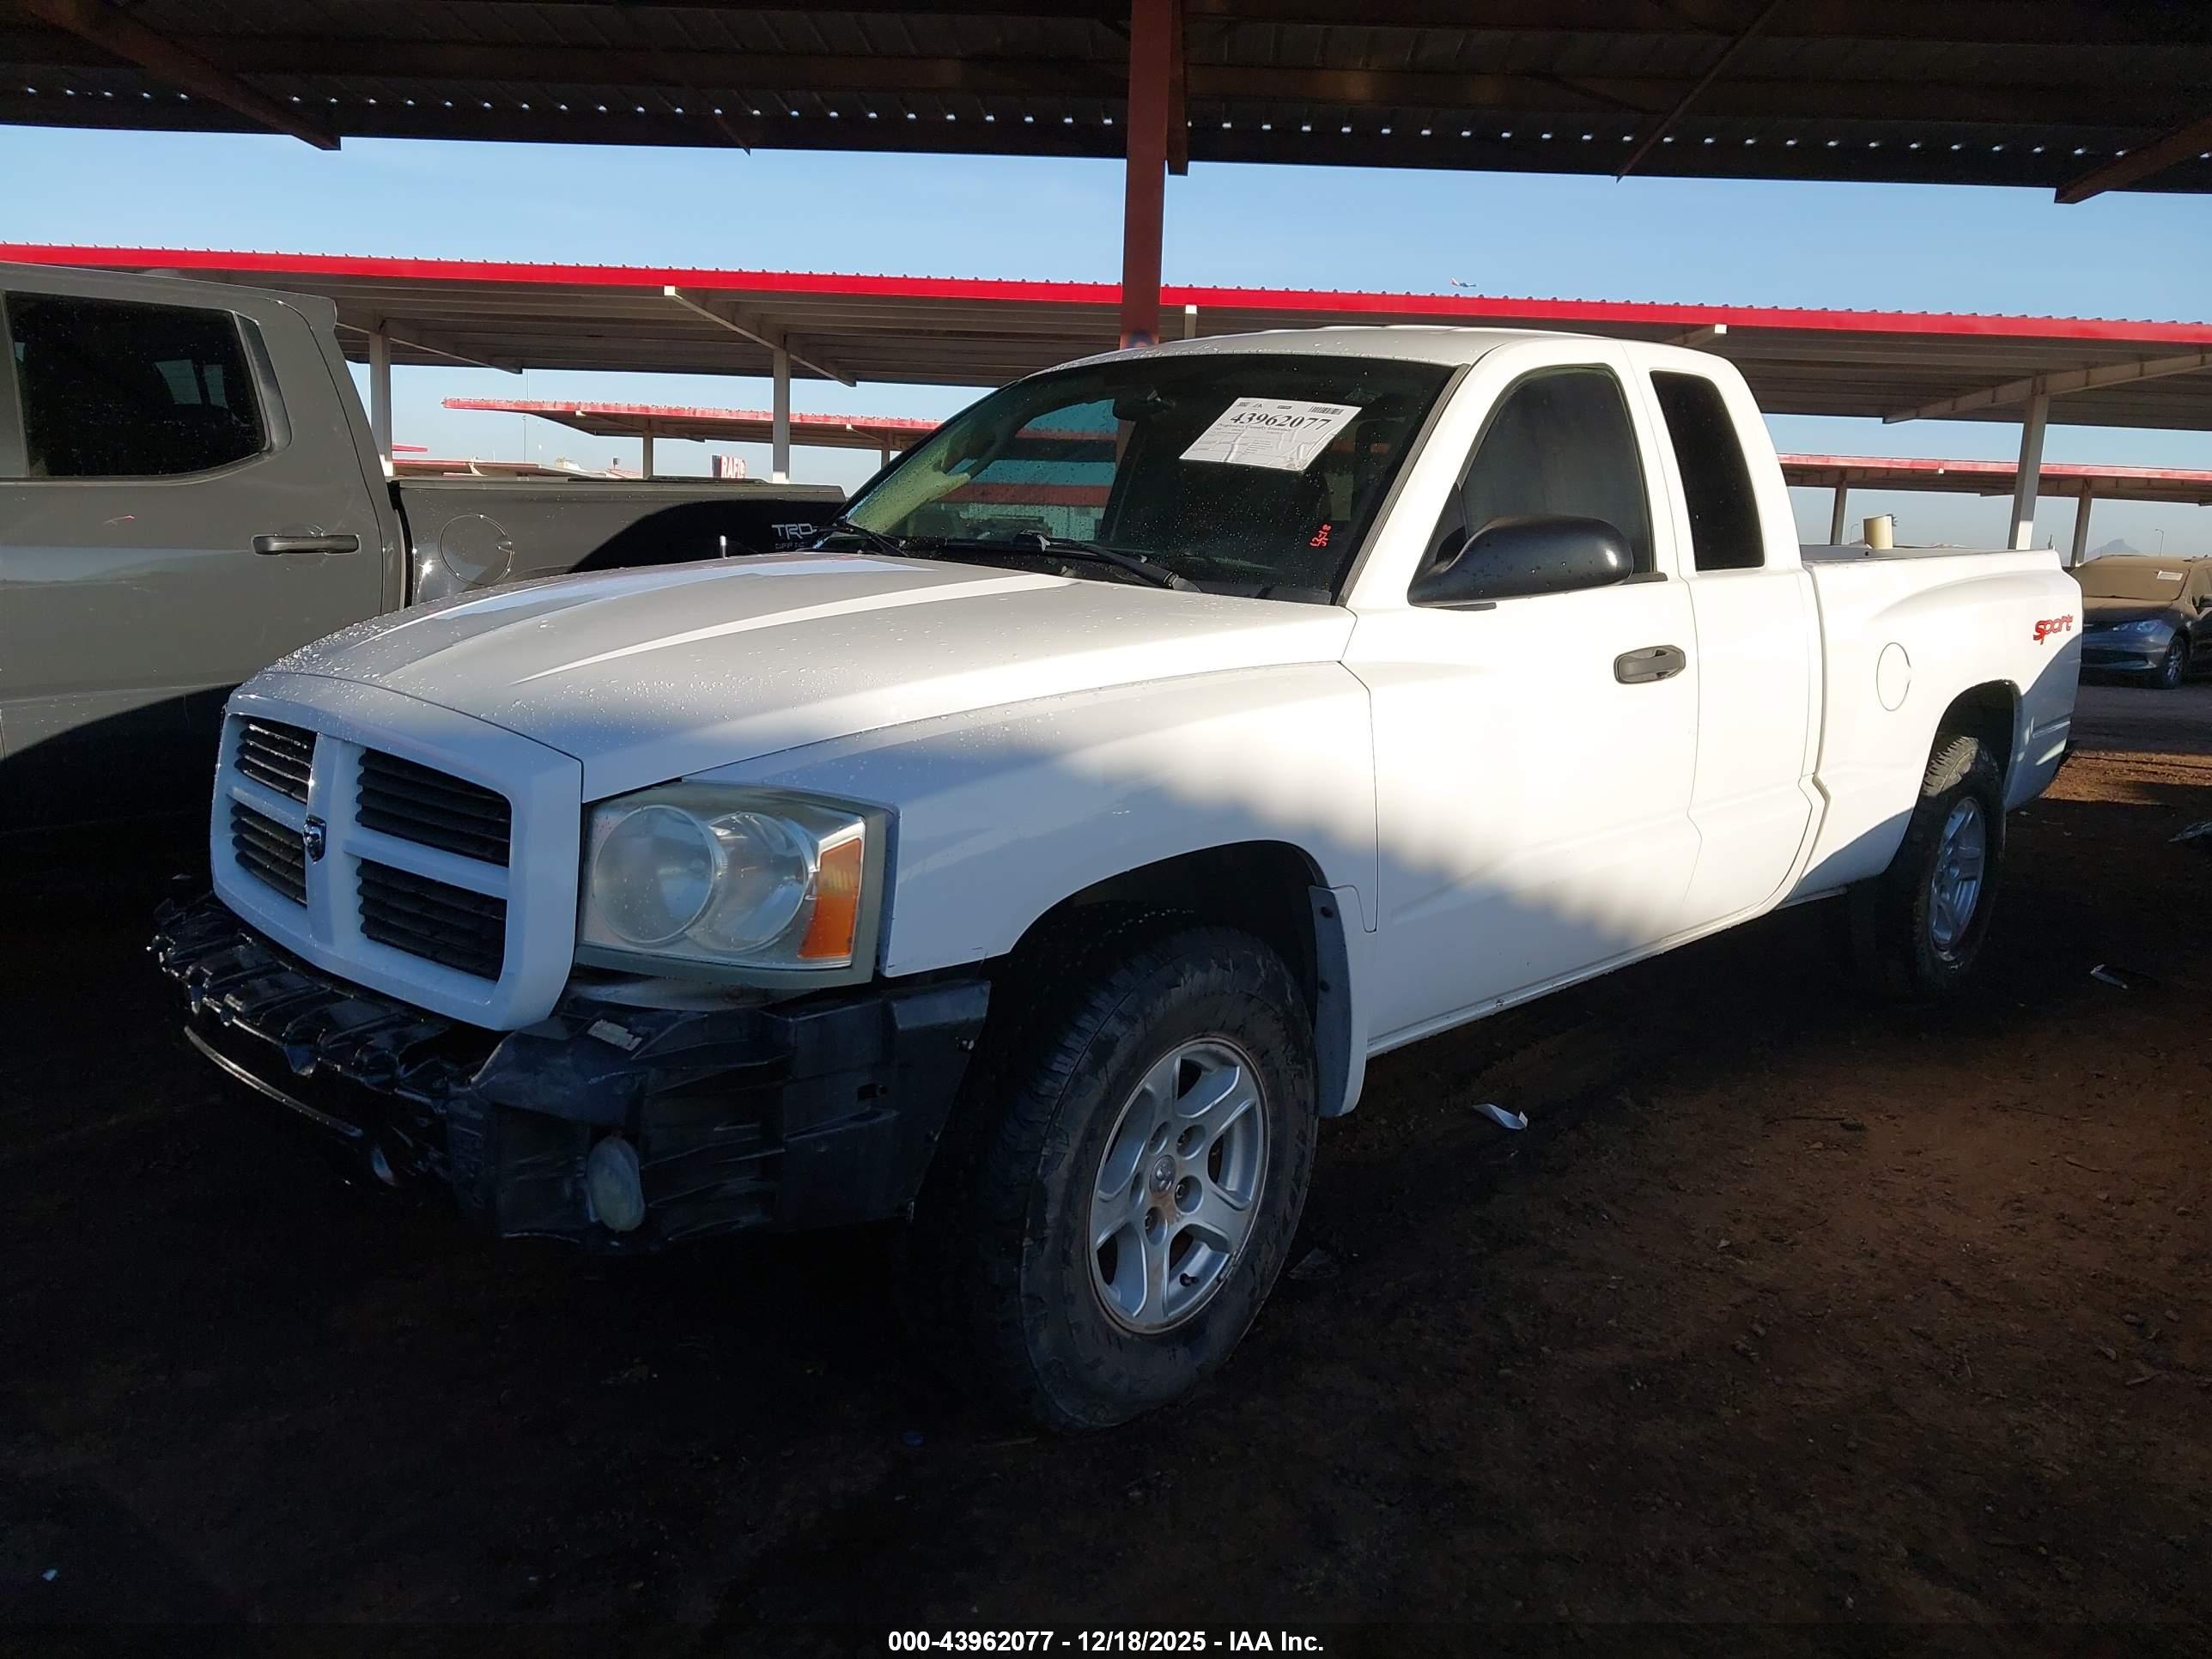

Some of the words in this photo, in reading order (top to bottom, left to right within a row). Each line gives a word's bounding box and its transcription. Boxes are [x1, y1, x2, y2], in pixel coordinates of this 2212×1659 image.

[1230, 411, 1333, 431] 43962077
[771, 522, 816, 540] TRD
[2033, 614, 2074, 646] Sport
